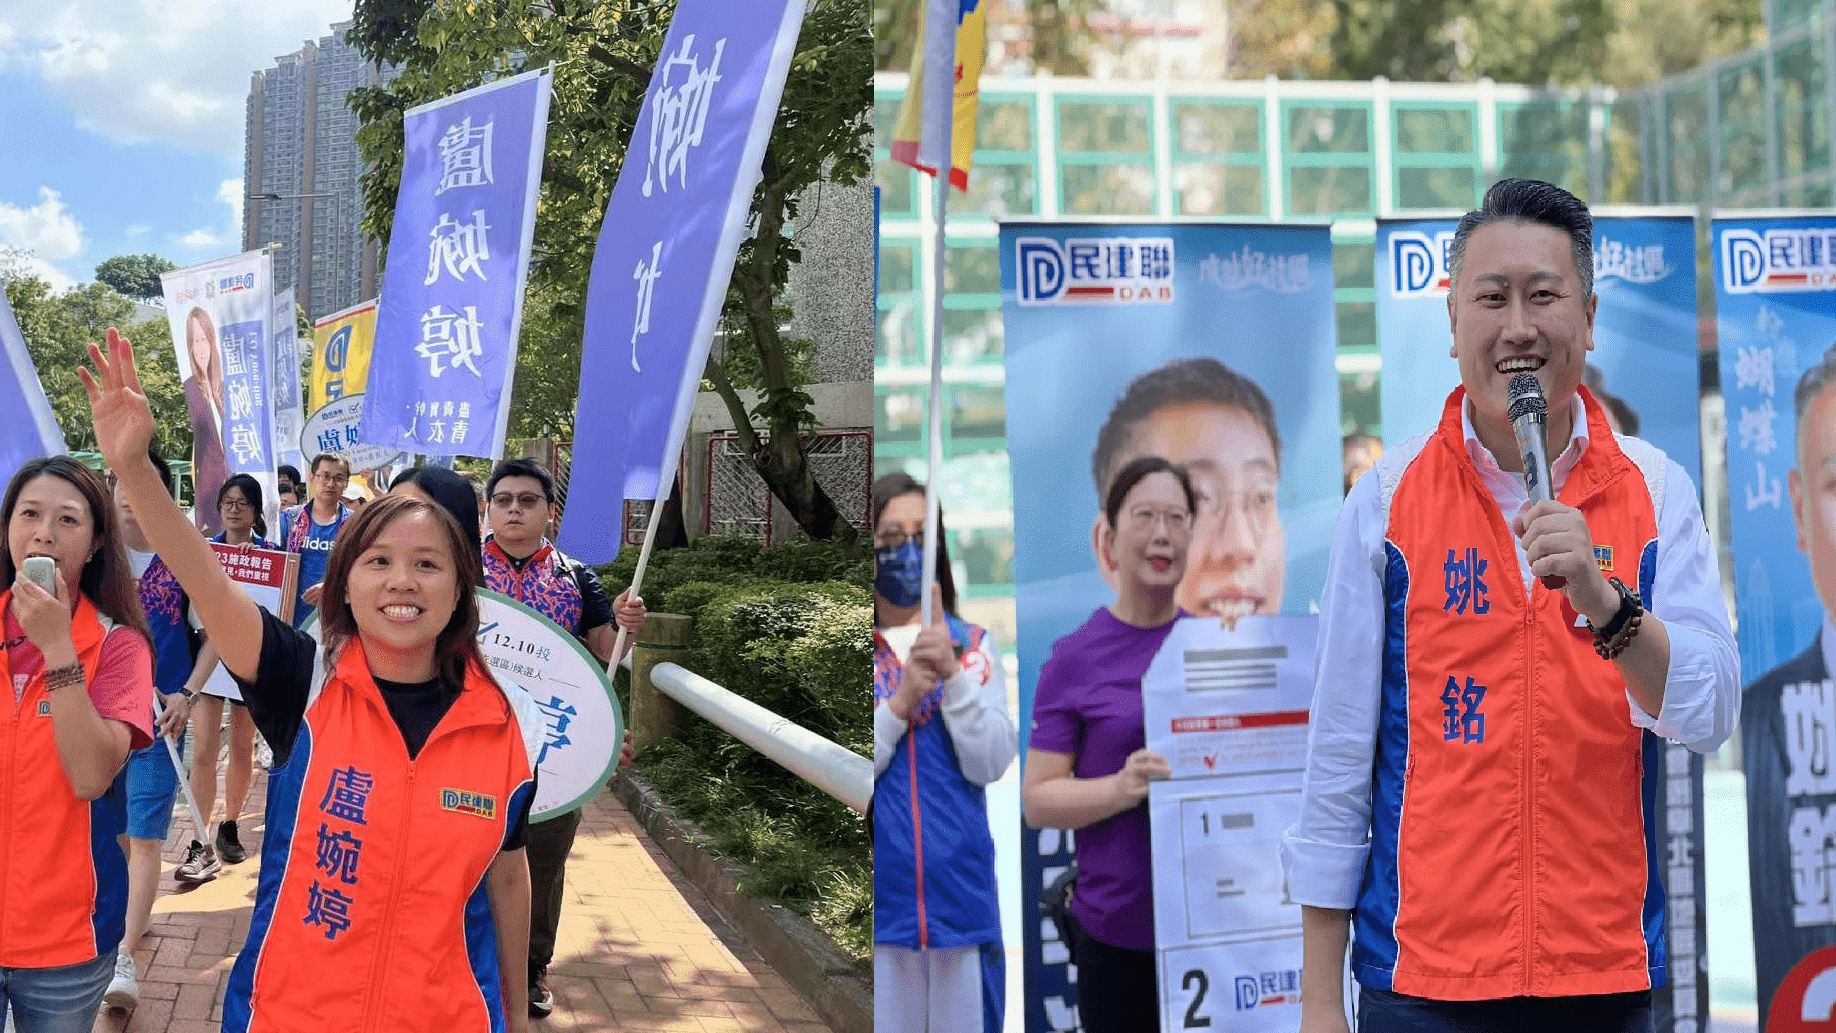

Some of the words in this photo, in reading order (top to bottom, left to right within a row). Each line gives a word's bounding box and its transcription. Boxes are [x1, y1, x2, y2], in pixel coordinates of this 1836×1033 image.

[1071, 245, 1170, 279] 民建聯
[1594, 235, 1670, 282] 好社區
[1119, 287, 1171, 299] DAB
[1736, 345, 1781, 511] 蝴蝶山
[301, 536, 336, 551] idas
[1441, 547, 1491, 744] 姚銘
[302, 765, 375, 940] 盧婉婷
[1182, 968, 1212, 1030] 2
[1260, 968, 1303, 995] 民建
